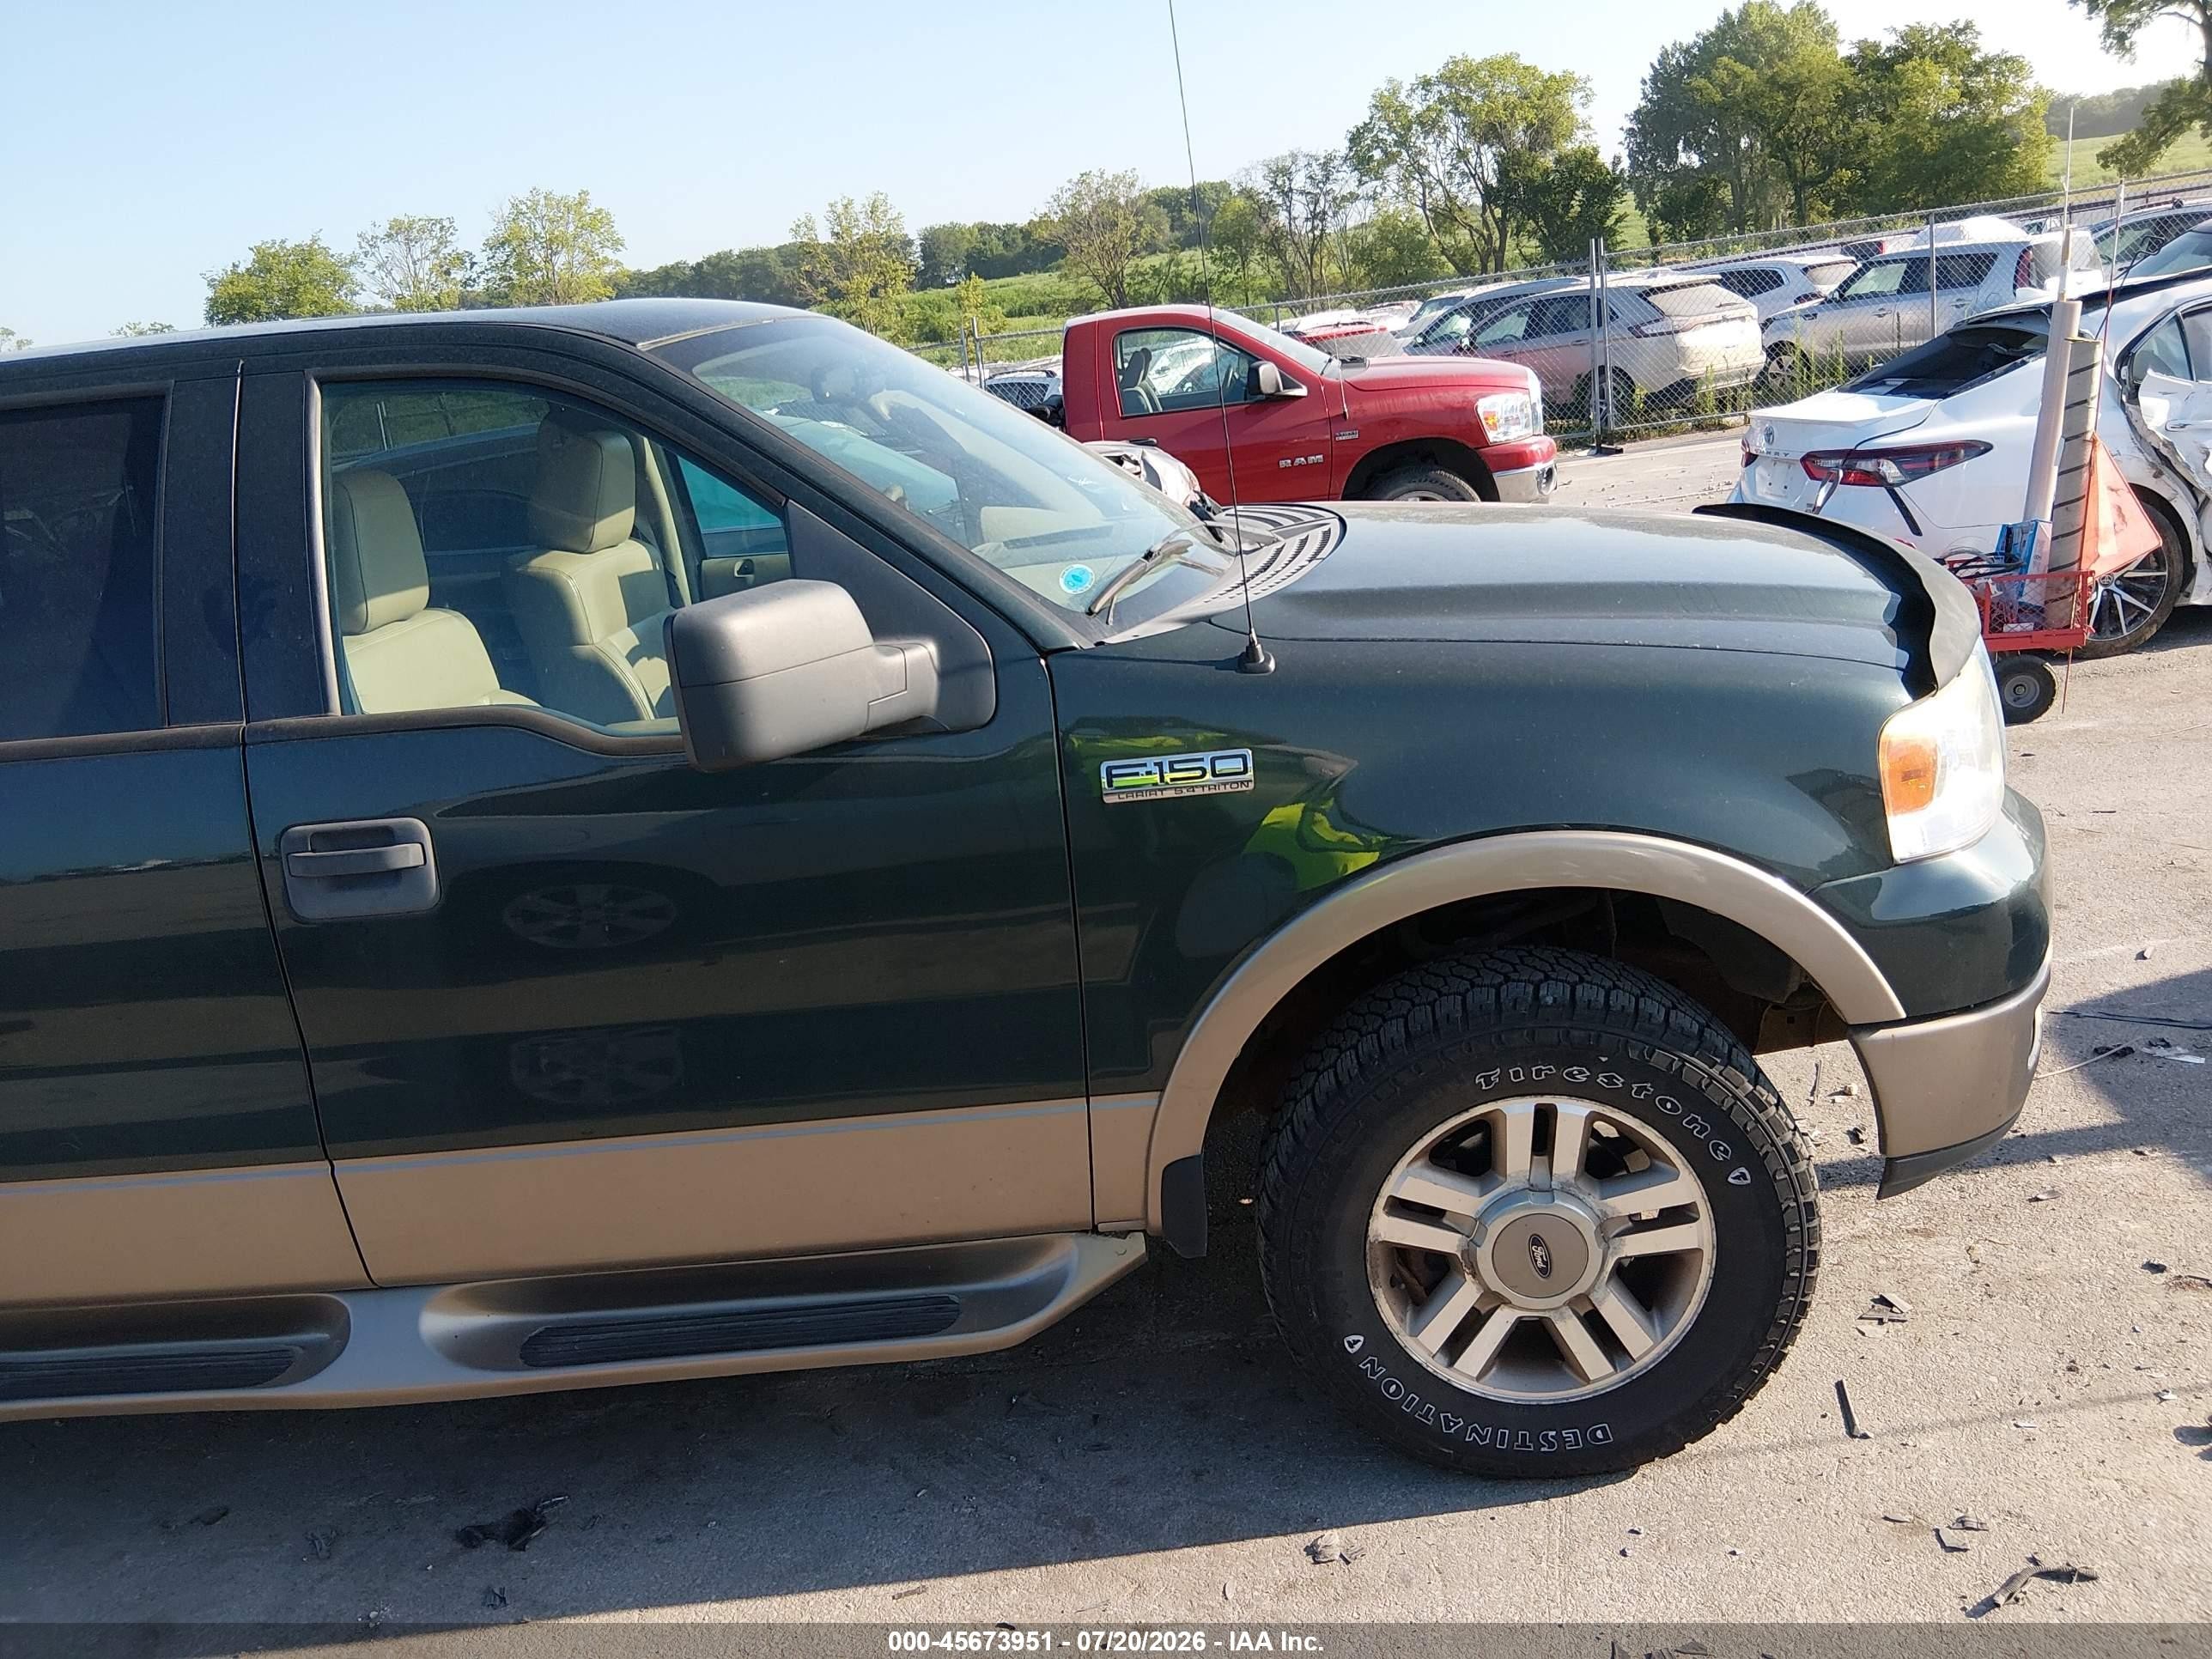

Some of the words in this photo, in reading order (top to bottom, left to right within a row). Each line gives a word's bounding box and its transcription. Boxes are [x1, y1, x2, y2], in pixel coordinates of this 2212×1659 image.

[1279, 454, 1324, 468] RAM
[1106, 754, 1249, 788] F-150
[1117, 788, 1166, 800] LARIAT
[1174, 786, 1196, 795] 5.4
[1198, 781, 1250, 793] TRITON
[1475, 1065, 1732, 1161] Firestone
[1358, 1356, 1613, 1452] DESTINATION
